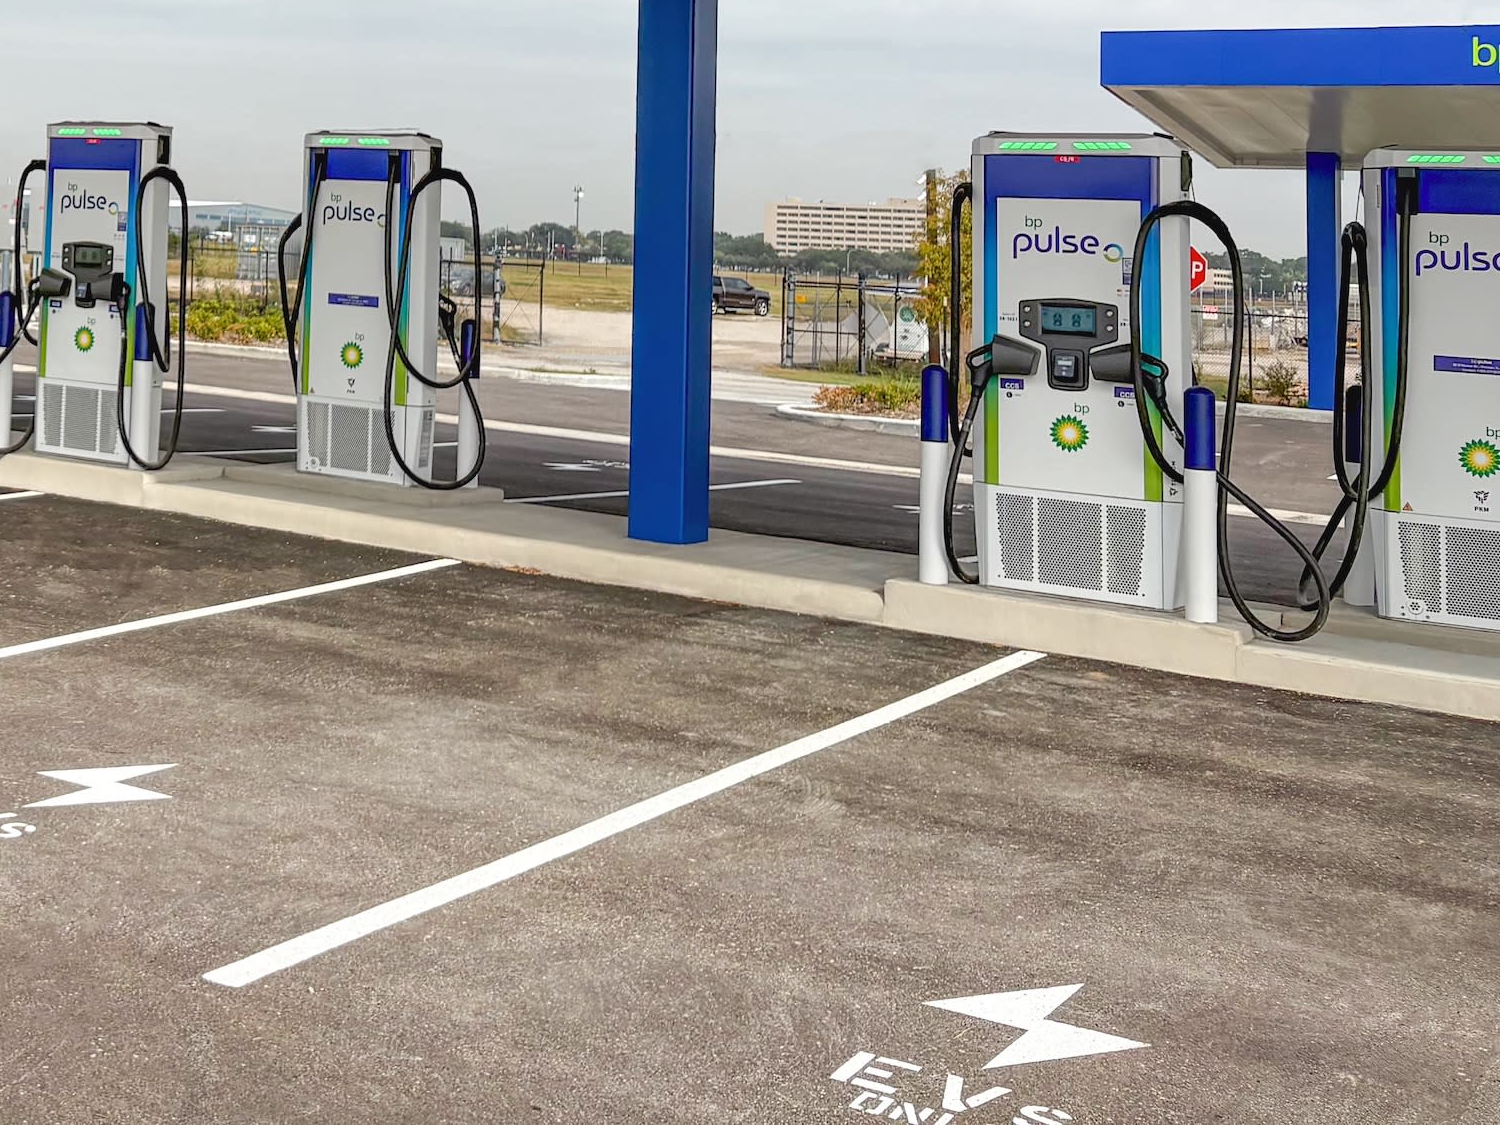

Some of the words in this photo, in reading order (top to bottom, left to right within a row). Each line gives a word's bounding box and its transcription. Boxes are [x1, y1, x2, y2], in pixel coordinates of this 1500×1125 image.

[1472, 36, 1500, 74] b
[67, 181, 78, 193] bp
[60, 188, 107, 214] pulse
[330, 192, 342, 204] bp
[323, 200, 375, 225] pulse
[1024, 215, 1043, 230] bp
[1013, 226, 1099, 259] pulse
[1429, 231, 1450, 246] bp
[1074, 402, 1090, 414] bp
